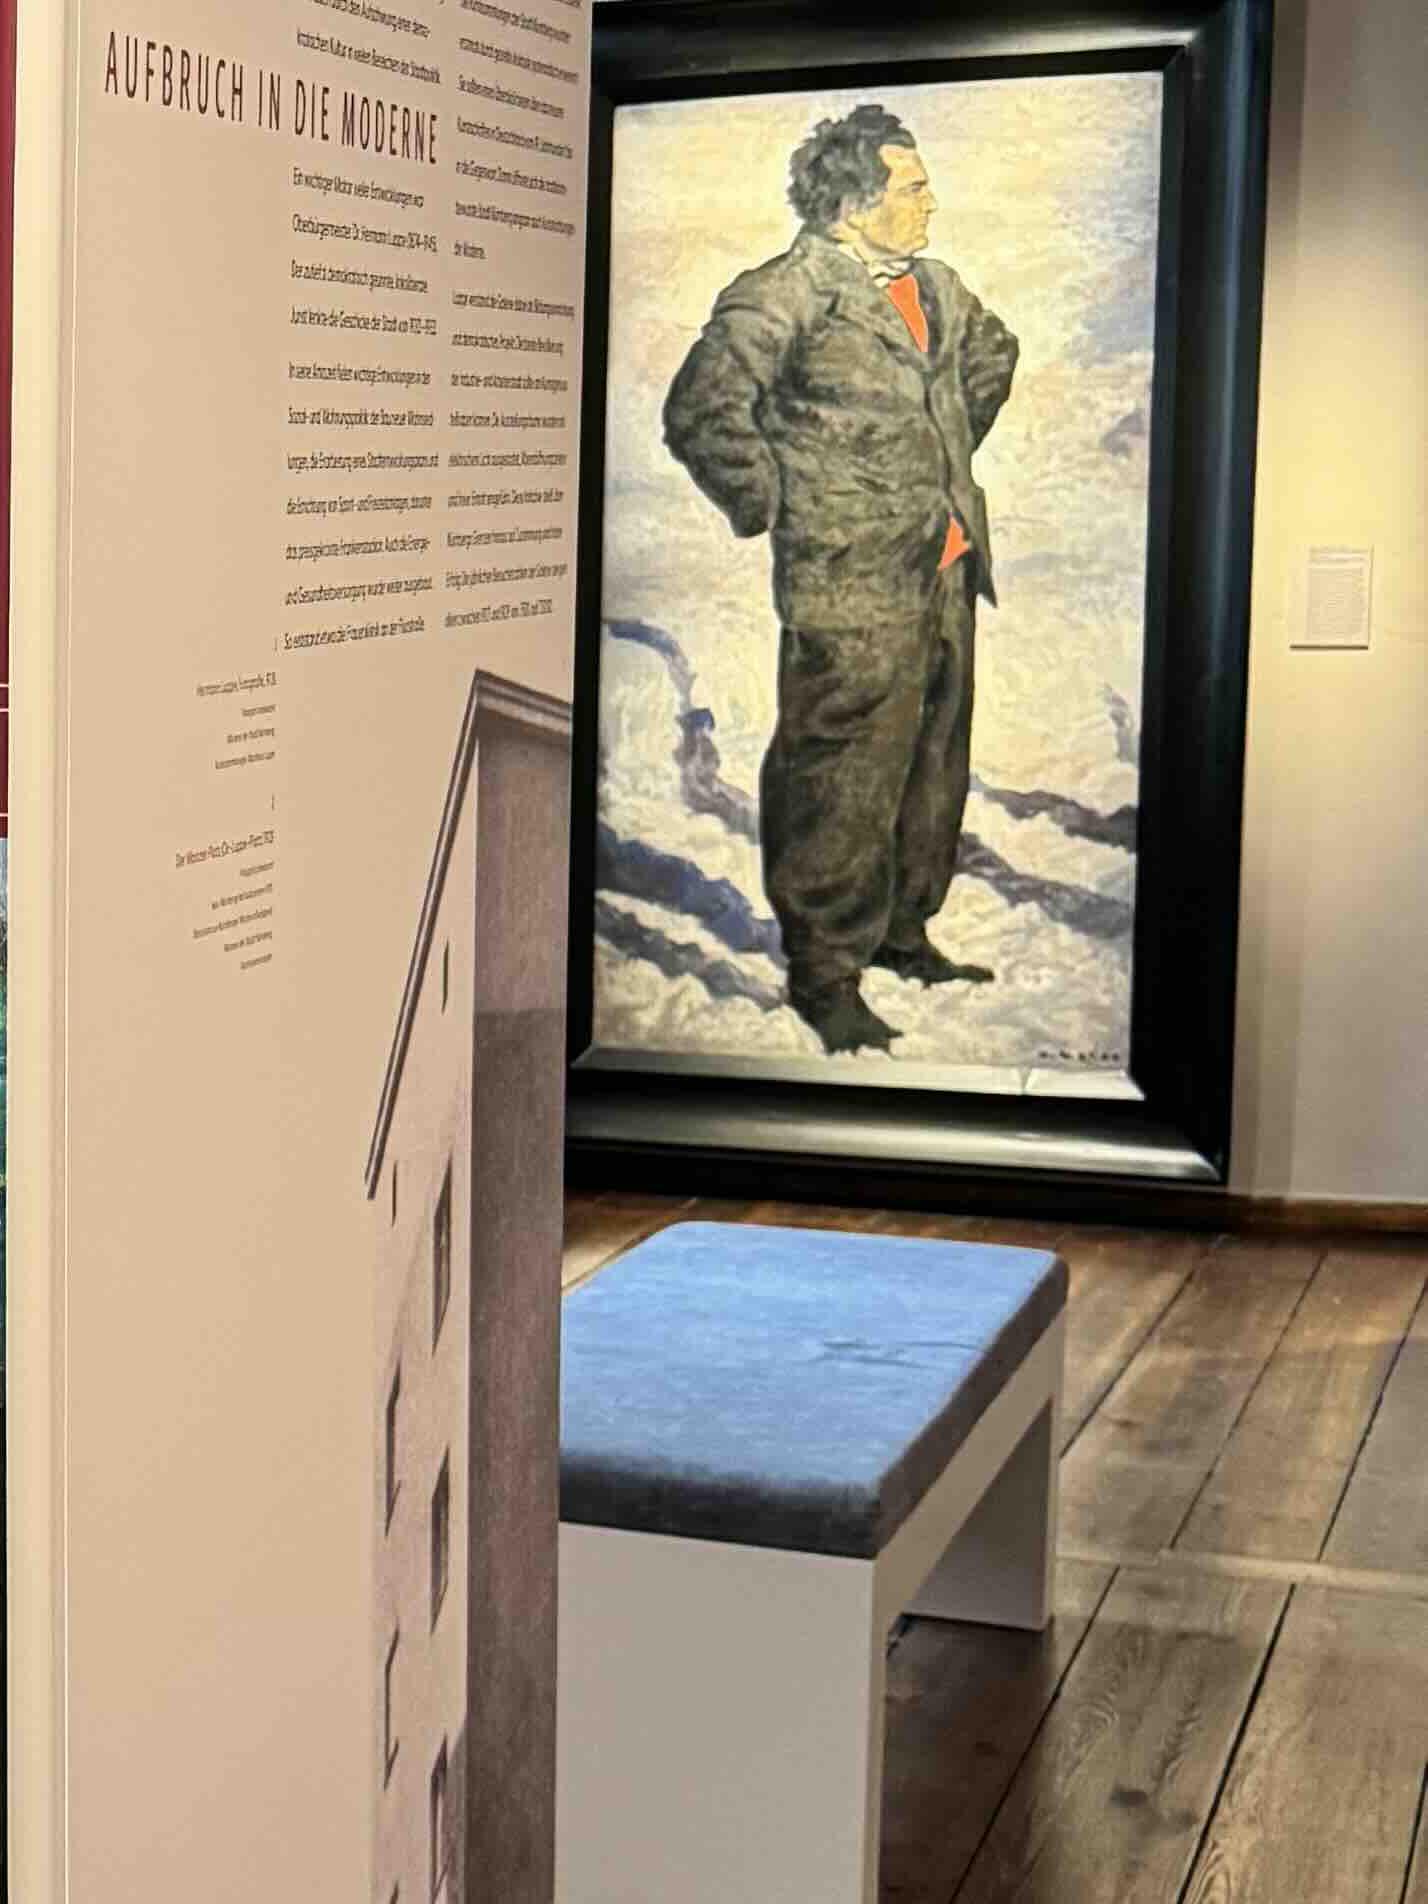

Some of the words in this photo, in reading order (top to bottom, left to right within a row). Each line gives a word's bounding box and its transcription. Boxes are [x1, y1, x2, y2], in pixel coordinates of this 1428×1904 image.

[104, 31, 243, 123] AUFBRUCH
[257, 69, 281, 131] IN
[293, 79, 330, 141] DIE
[341, 91, 437, 164] MODERNE
